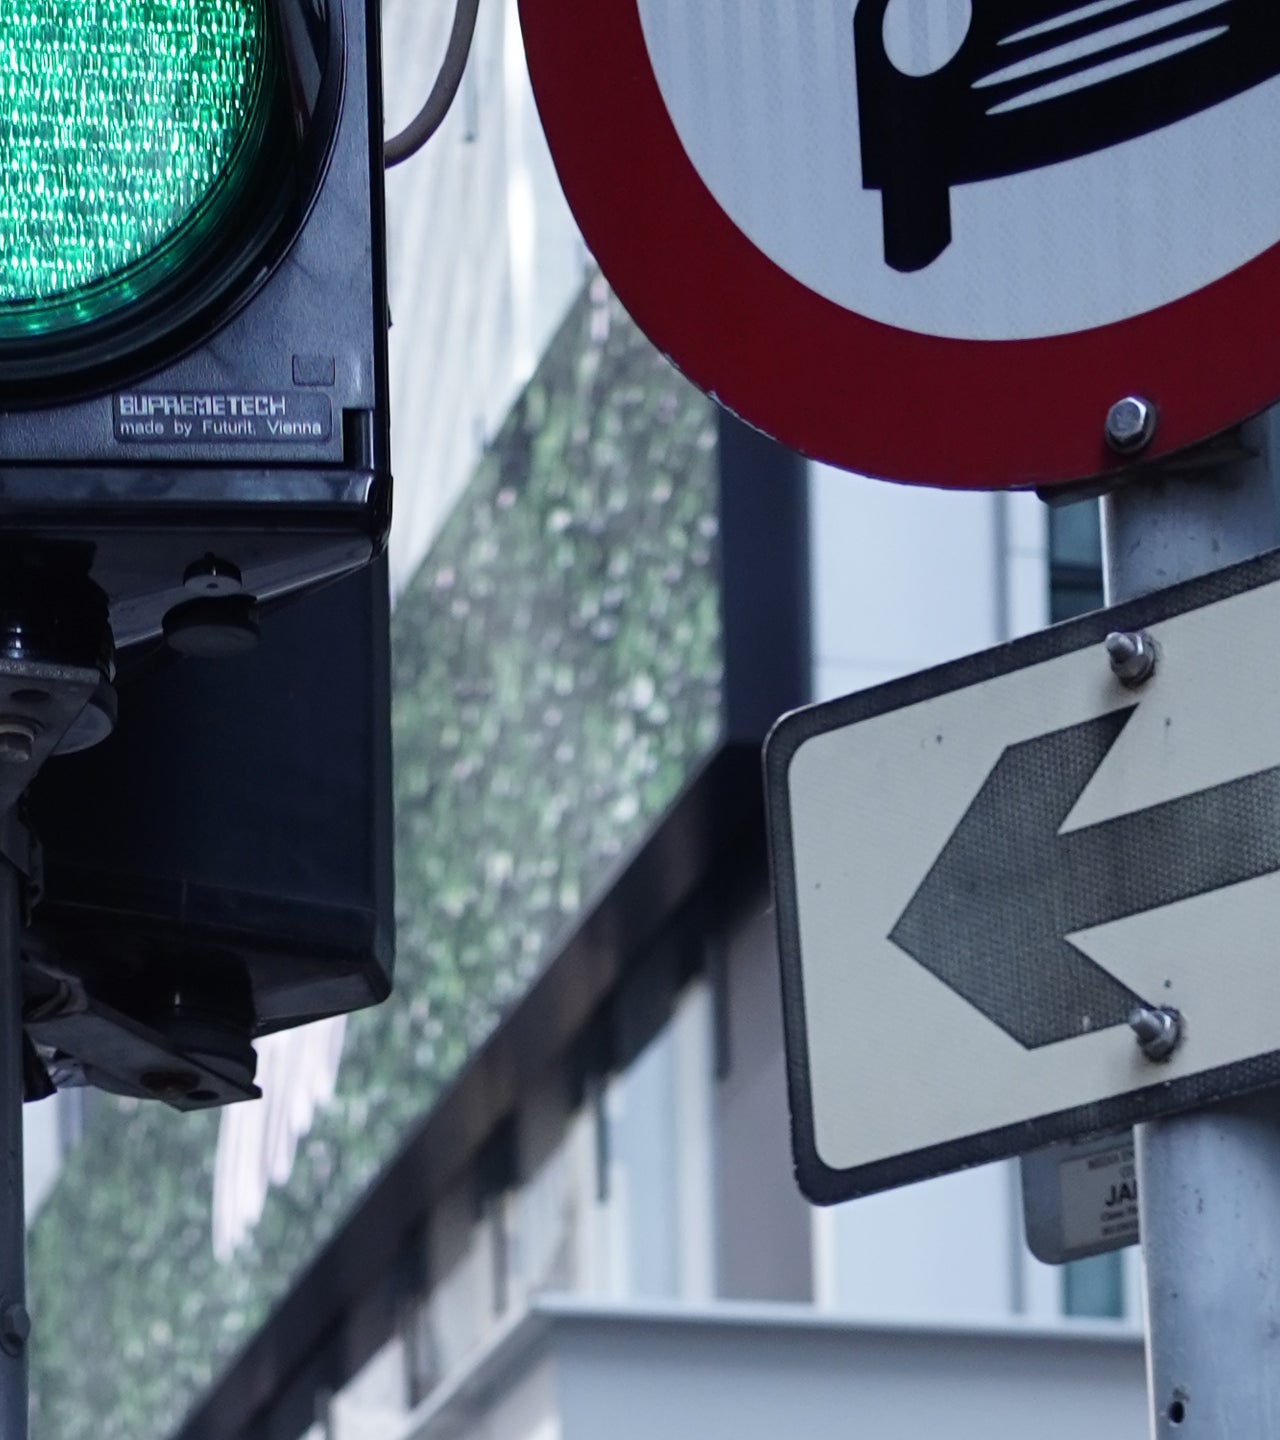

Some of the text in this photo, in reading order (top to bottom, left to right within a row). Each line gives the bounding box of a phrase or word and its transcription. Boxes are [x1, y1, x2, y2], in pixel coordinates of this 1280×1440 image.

[120, 395, 286, 415] SUPREMETECH
[120, 421, 164, 436] made
[174, 419, 192, 437] by
[268, 419, 322, 436] Vienna
